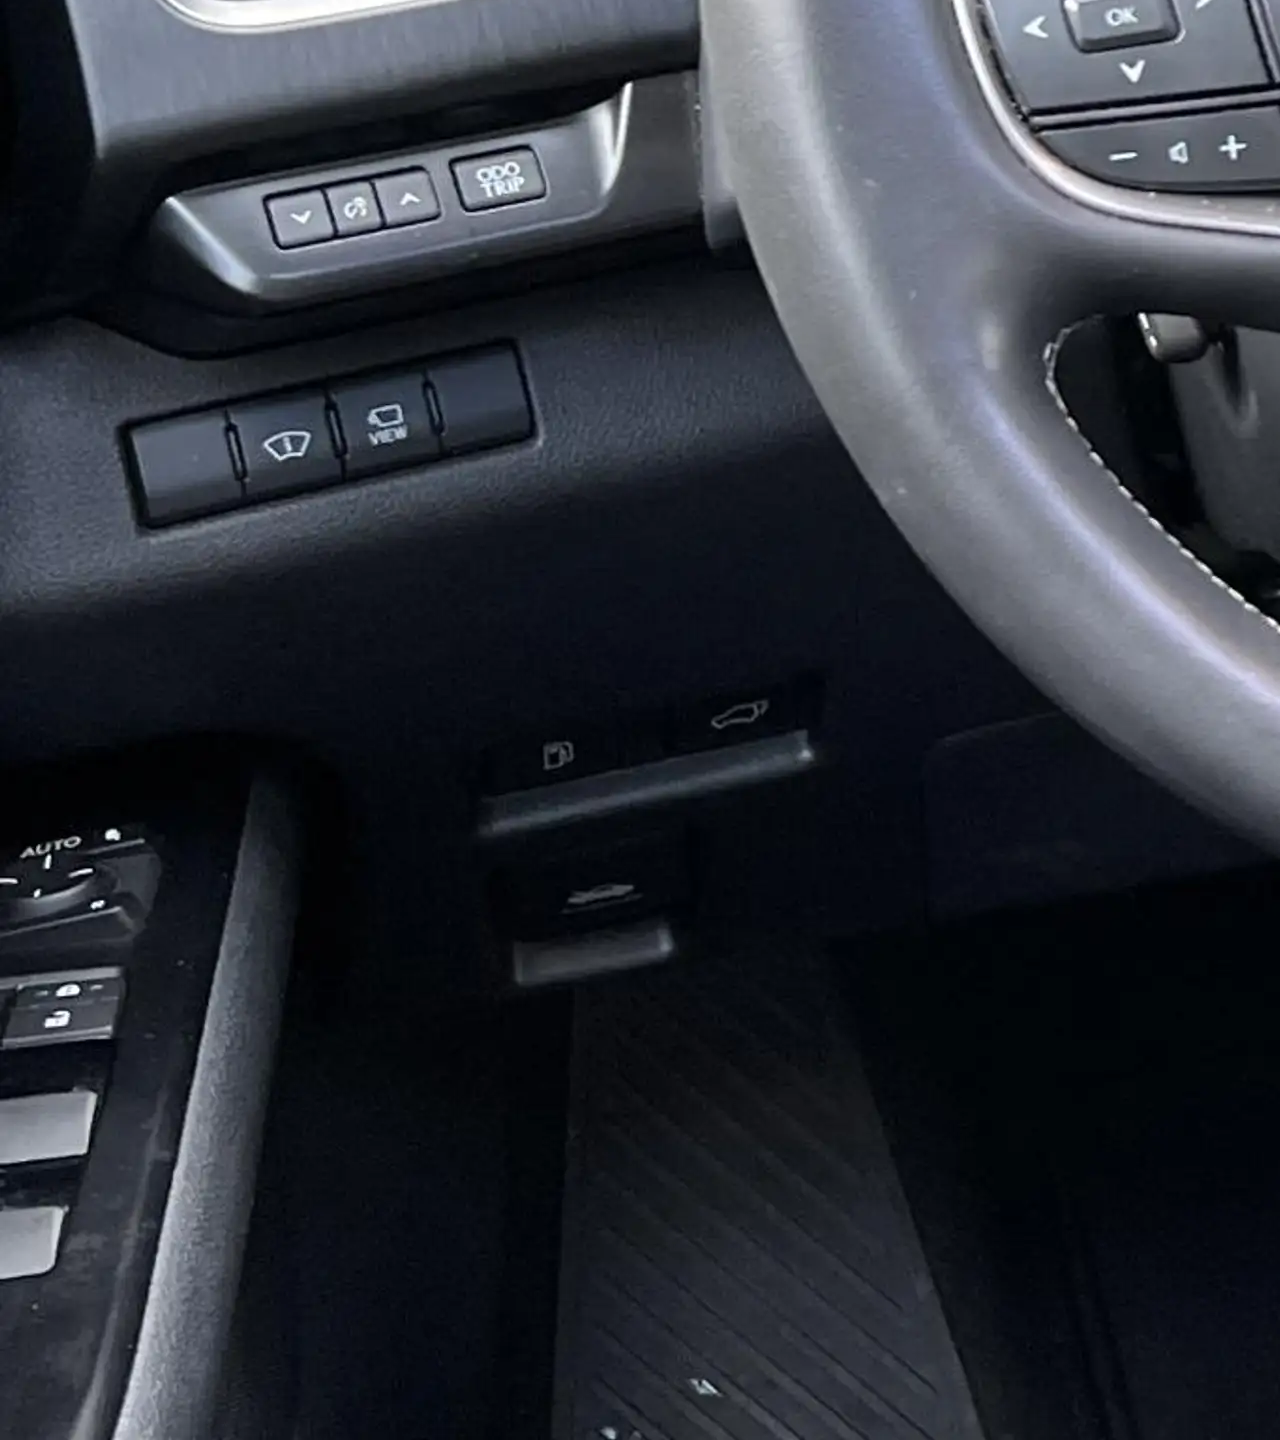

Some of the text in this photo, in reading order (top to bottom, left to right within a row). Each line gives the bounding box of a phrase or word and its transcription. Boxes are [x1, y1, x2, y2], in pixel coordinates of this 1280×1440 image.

[1106, 5, 1139, 27] OK
[476, 161, 521, 182] ODO
[480, 176, 525, 198] TRIP
[368, 424, 408, 446] VIEW
[20, 836, 82, 859] AUTO
